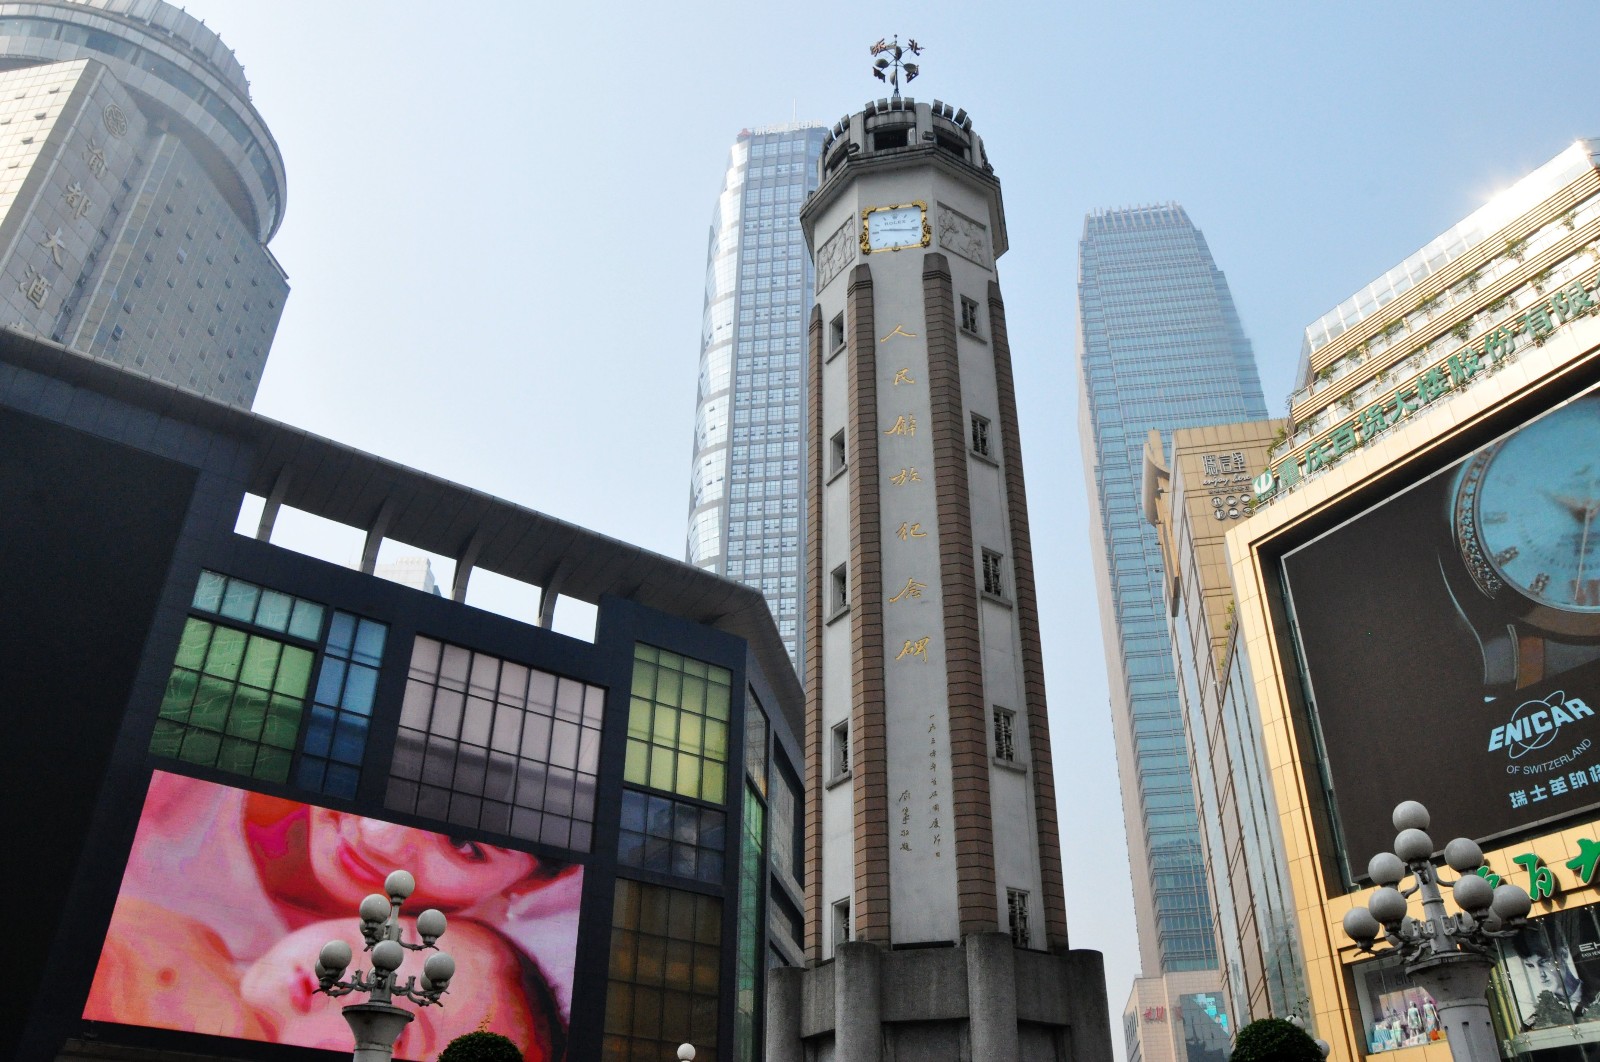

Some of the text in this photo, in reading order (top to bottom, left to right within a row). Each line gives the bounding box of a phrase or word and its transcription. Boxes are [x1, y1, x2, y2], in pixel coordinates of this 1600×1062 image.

[9, 137, 109, 331] 渝都大酒
[1277, 270, 1600, 490] 重庆百货大楼股份有限
[1488, 698, 1595, 752] ENICAR
[1506, 738, 1592, 774] OF SWITZERLAND
